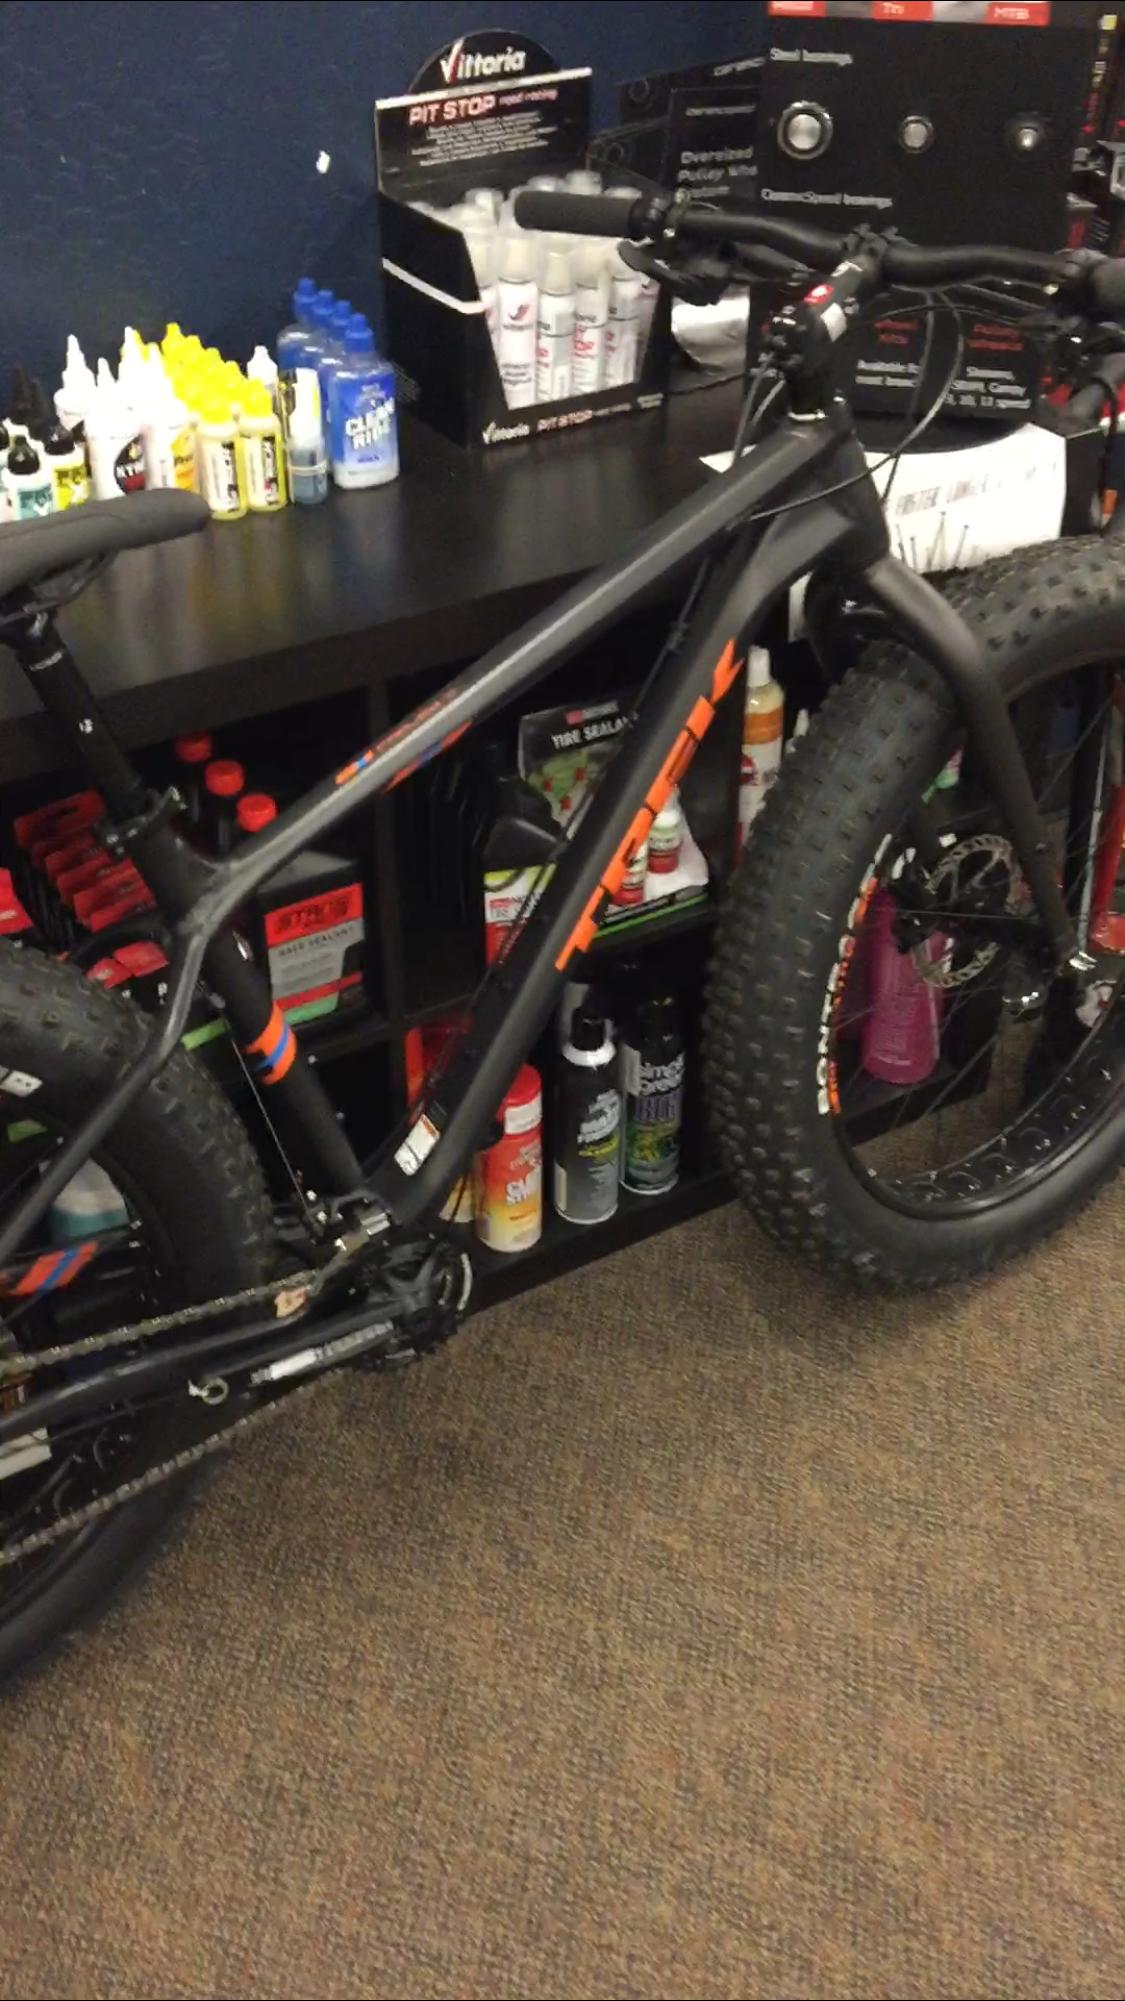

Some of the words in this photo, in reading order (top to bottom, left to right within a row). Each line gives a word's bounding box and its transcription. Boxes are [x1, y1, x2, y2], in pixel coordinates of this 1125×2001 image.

[440, 37, 526, 83] Vittoria
[409, 104, 440, 125] PIT
[443, 94, 496, 120] STOP
[552, 729, 582, 750] TIRE
[554, 637, 745, 972] TREK
